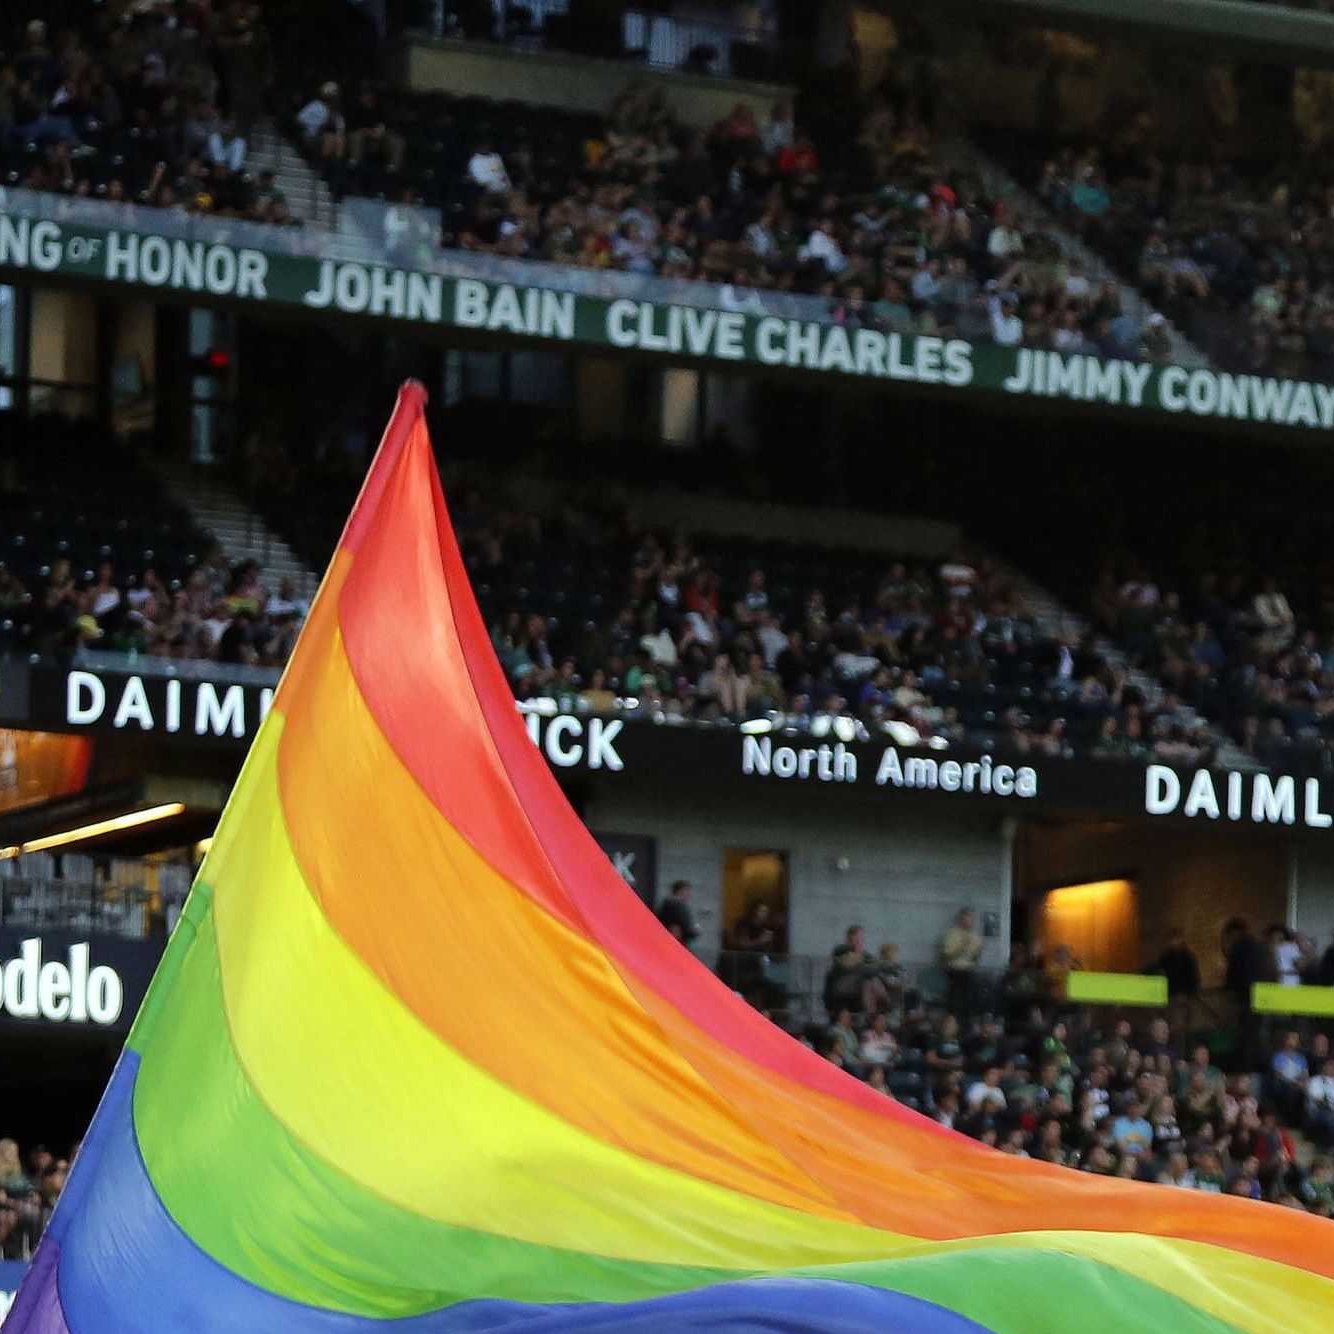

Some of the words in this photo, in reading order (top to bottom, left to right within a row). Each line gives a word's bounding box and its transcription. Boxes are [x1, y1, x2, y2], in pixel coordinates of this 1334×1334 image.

[68, 236, 103, 264] OF
[105, 230, 269, 299] HONOR
[304, 259, 443, 324] JOHN
[454, 278, 577, 340] BAIN
[606, 298, 746, 360] CLIVE
[755, 316, 975, 388] CHARLES
[1003, 346, 1153, 406] JIMMY
[66, 670, 273, 739] DAIM
[742, 735, 858, 783] North
[874, 746, 1038, 797] America
